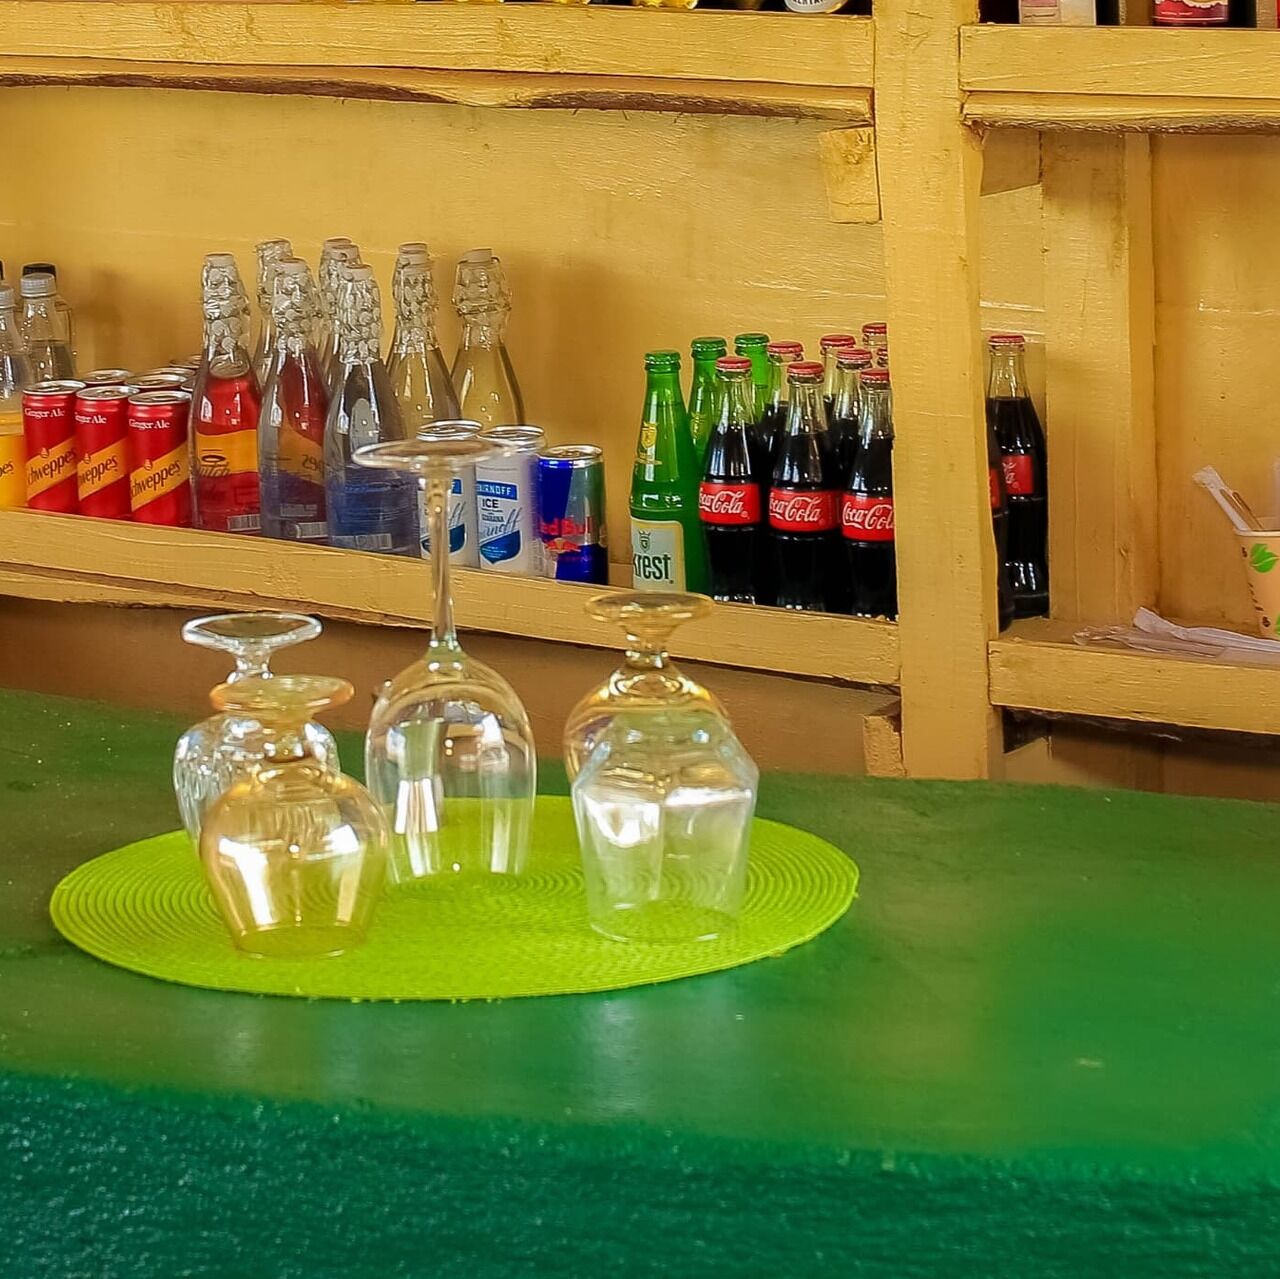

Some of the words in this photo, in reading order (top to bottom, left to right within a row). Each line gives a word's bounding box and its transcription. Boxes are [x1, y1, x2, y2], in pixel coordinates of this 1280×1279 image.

[50, 407, 65, 417] Ale
[91, 414, 107, 424] Ale
[155, 419, 170, 429] Ale
[27, 447, 77, 485] chweppes
[78, 454, 118, 486] weppes
[131, 459, 182, 497] chweppes
[482, 498, 500, 509] ICE
[699, 487, 745, 514] oca-Cola
[769, 492, 822, 522] oca-Cola
[539, 521, 560, 535] ed
[842, 501, 895, 530] Coca-Col
